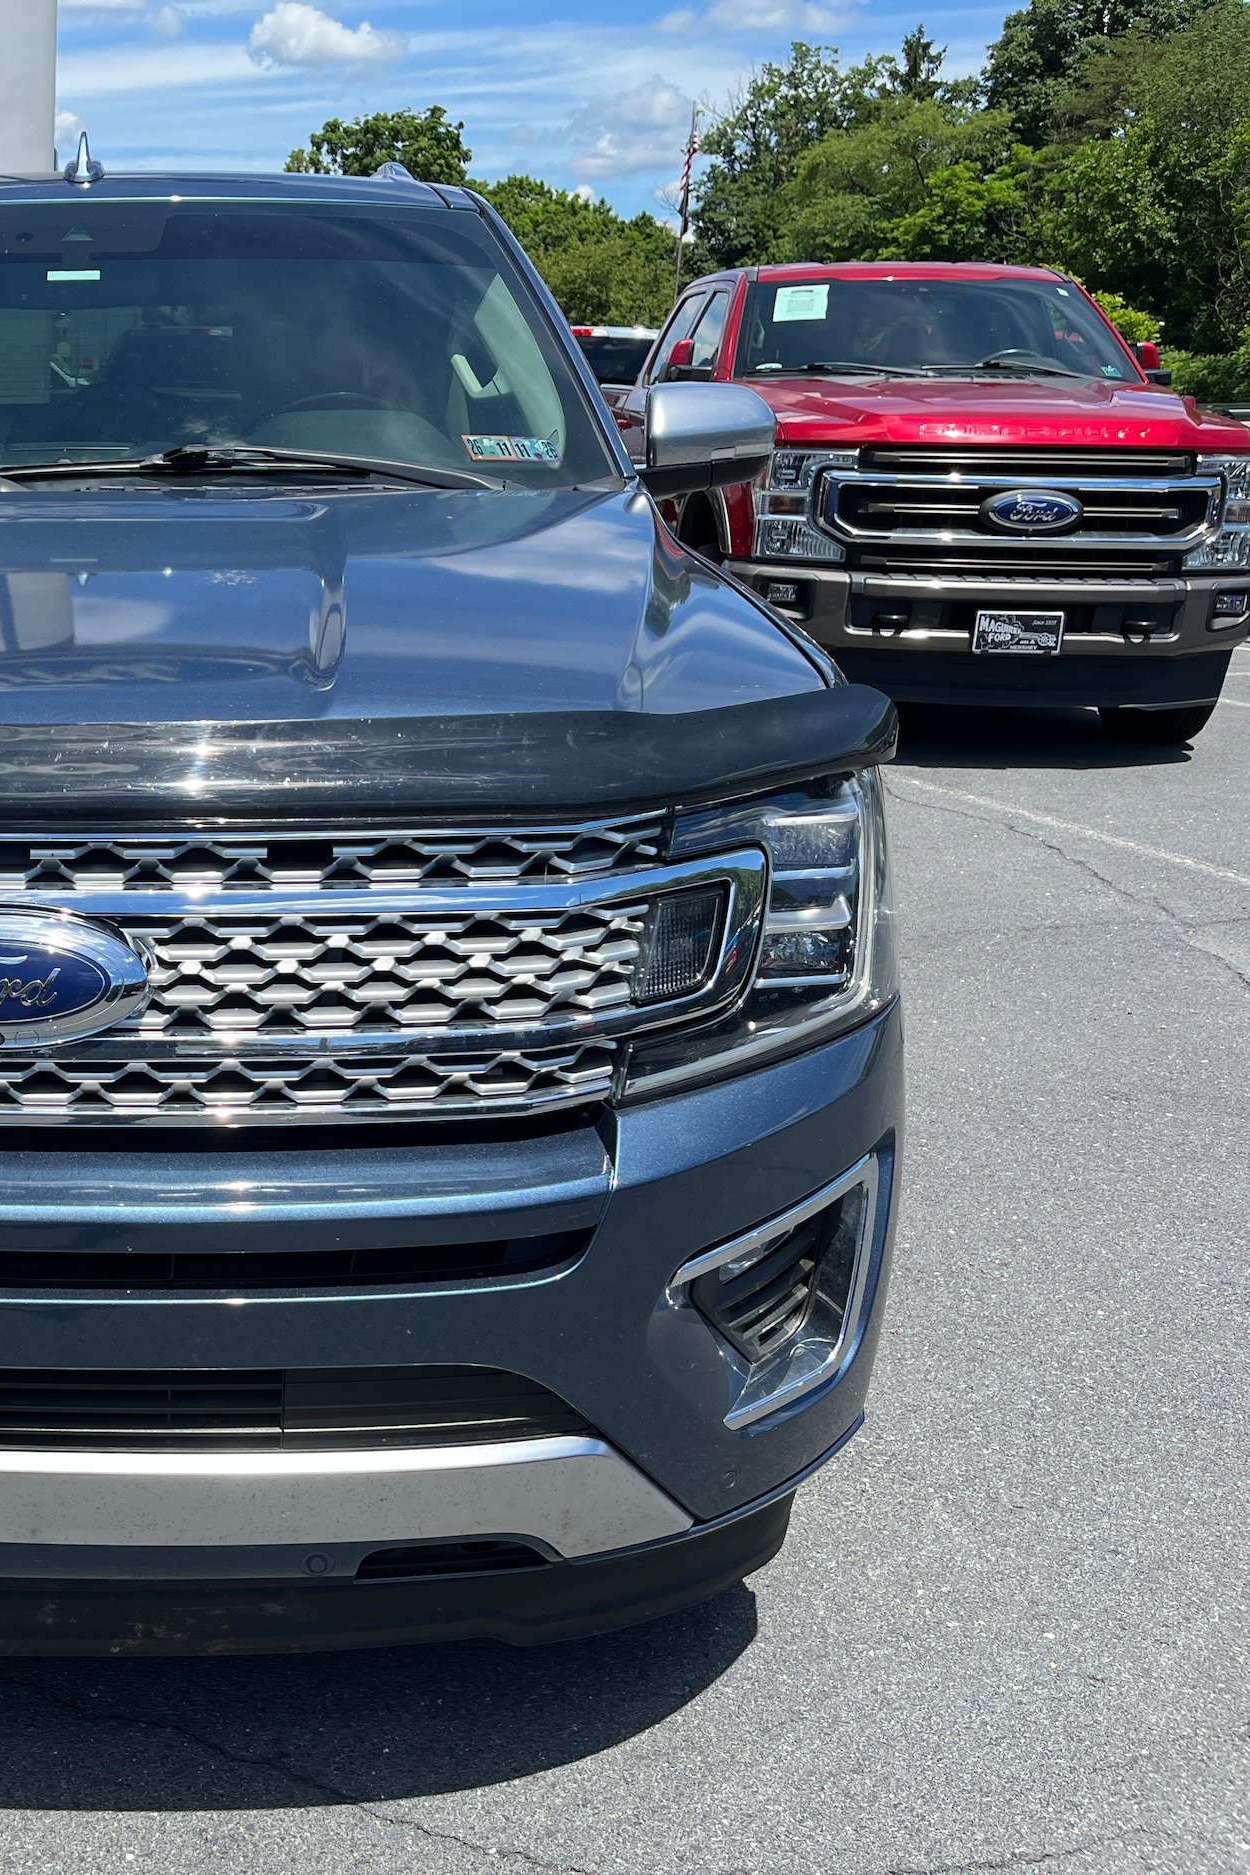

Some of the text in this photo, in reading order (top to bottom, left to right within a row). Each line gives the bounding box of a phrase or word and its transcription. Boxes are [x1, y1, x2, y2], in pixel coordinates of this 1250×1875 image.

[467, 438, 512, 456] 26 11
[515, 443, 531, 458] 11
[1010, 500, 1059, 521] Ford
[987, 632, 1012, 643] FORD
